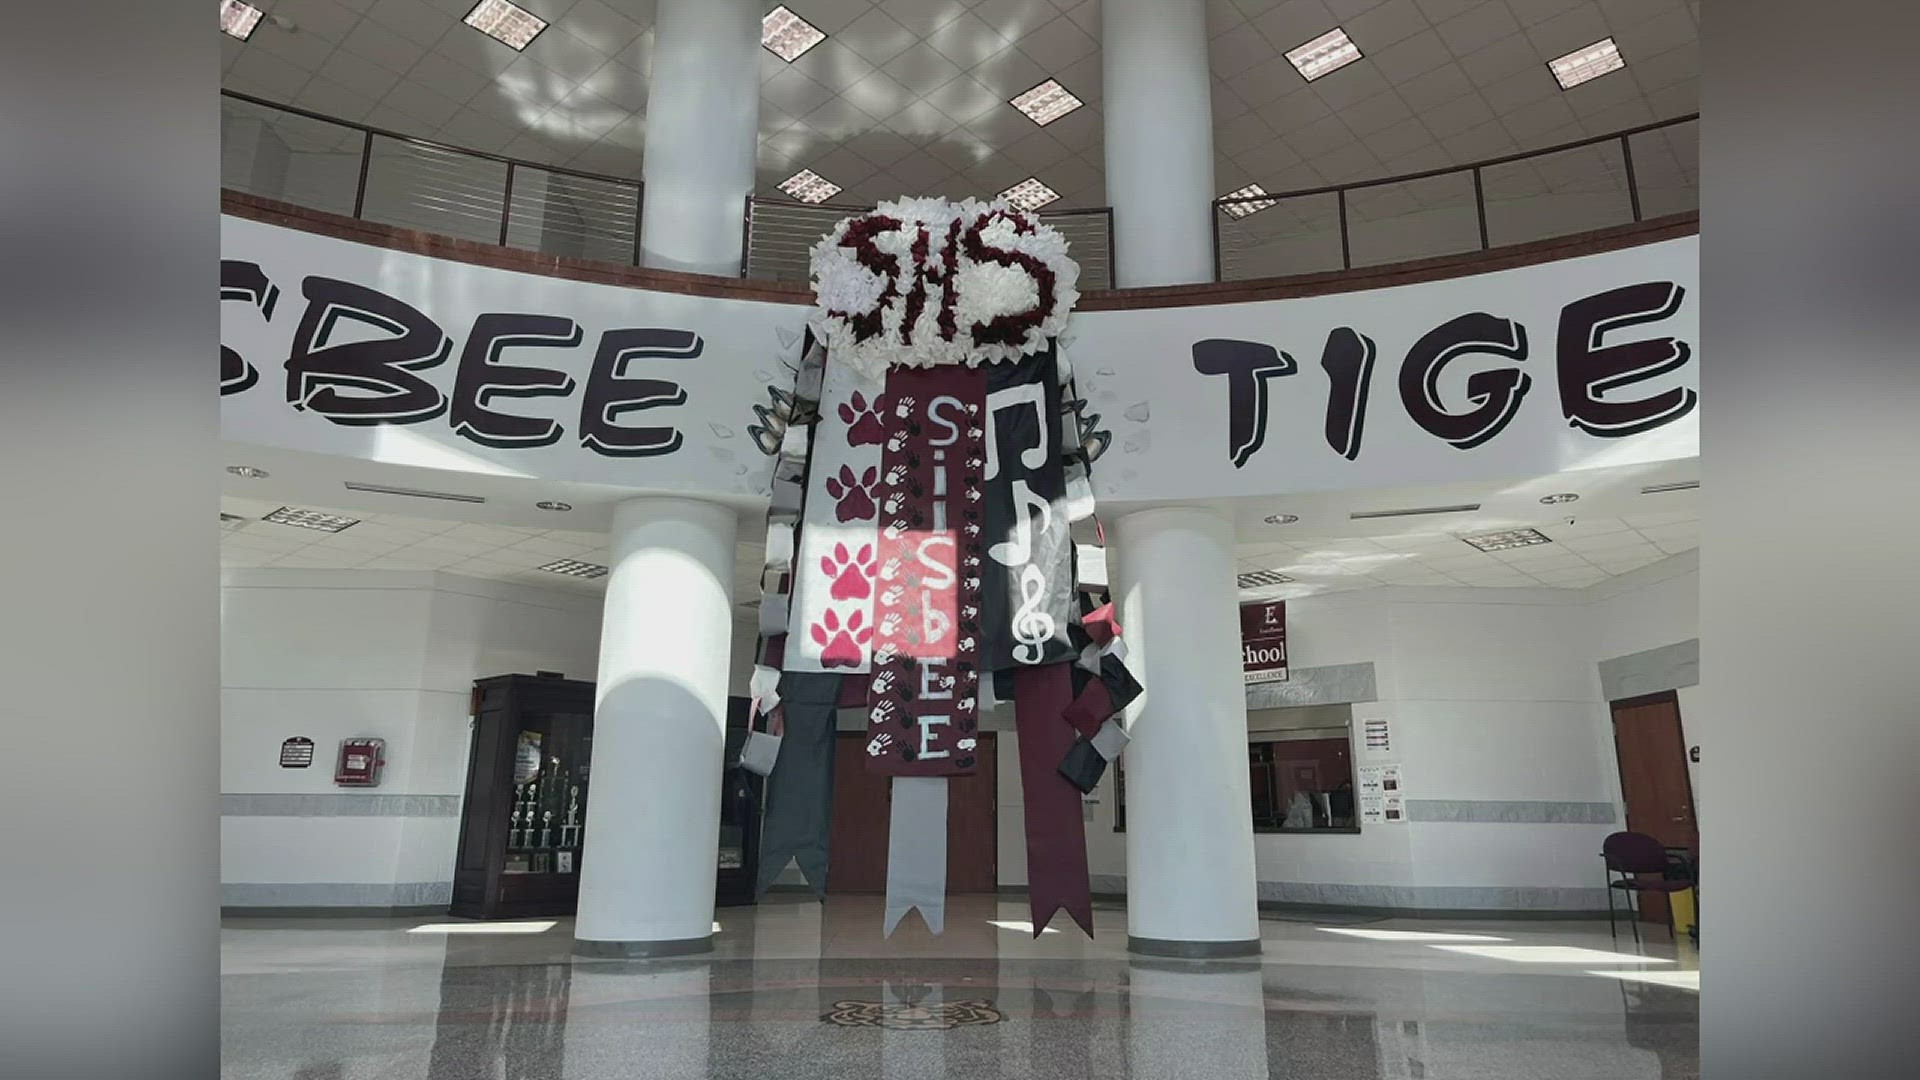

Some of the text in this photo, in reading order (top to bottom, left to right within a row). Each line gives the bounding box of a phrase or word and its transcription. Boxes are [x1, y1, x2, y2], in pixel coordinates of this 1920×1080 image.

[838, 208, 1056, 347] SHS
[1192, 281, 1697, 468] TIGE
[1242, 641, 1286, 664] hool
[1265, 606, 1278, 624] E
